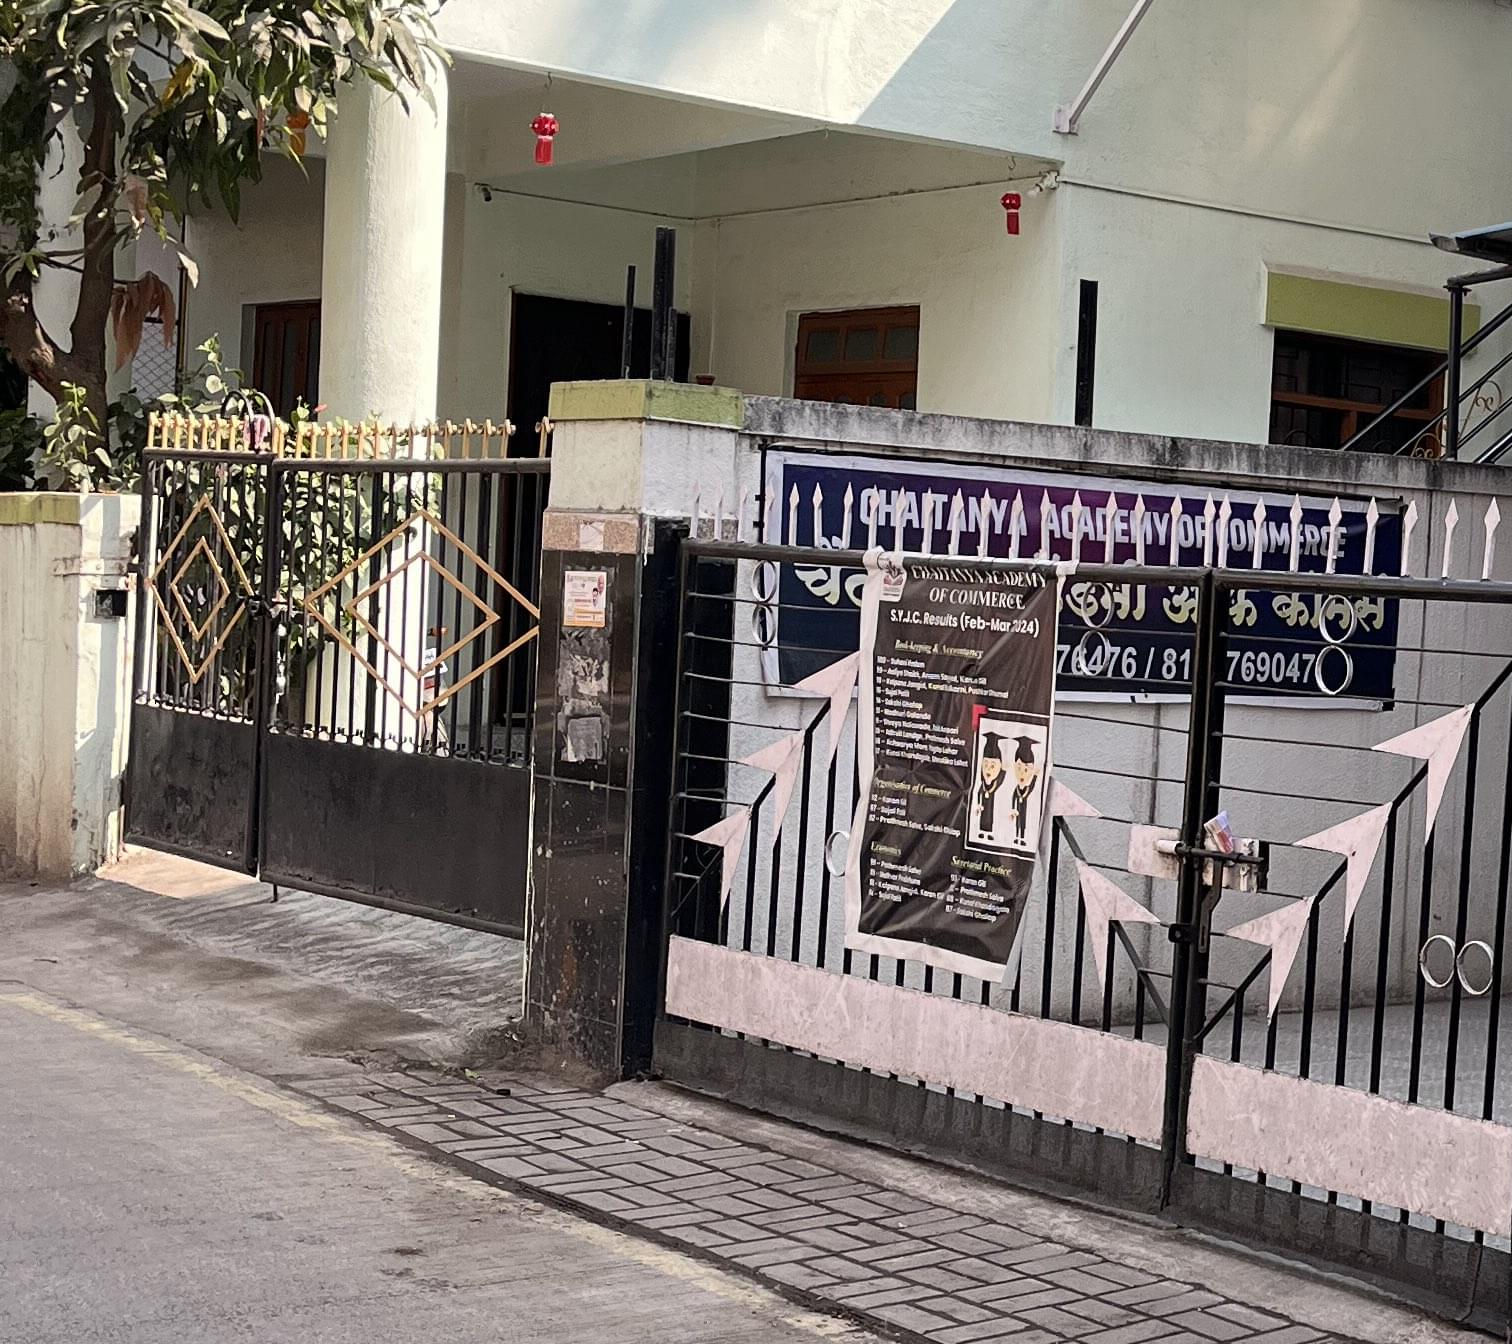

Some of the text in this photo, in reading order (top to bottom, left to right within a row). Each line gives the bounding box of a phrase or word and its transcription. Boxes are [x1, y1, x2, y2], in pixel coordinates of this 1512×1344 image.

[860, 487, 1028, 536] CHAITANYA
[1044, 504, 1170, 547] ACADEMY
[1178, 514, 1208, 549] OF
[911, 564, 1047, 589] CHAITANYA ACADEMY
[929, 587, 1026, 611] OF COMMERCE
[890, 608, 922, 624] S.Y.J.C.
[923, 612, 958, 628] Results
[960, 611, 1010, 633] (Feb-Mar
